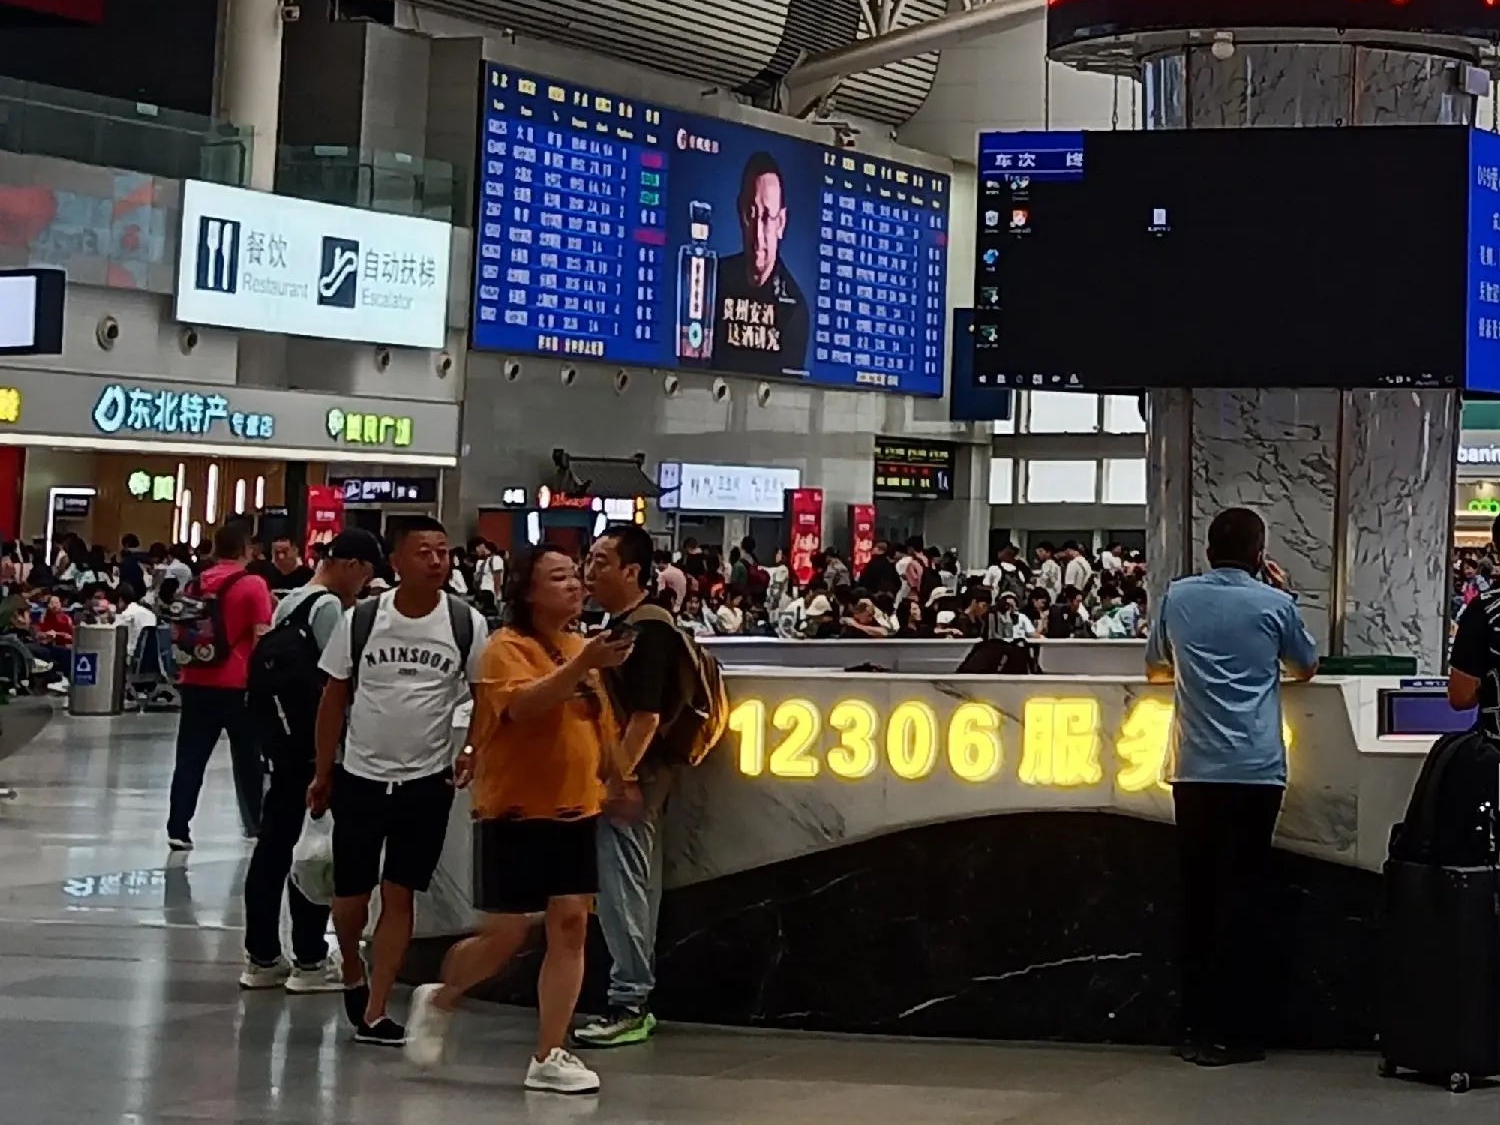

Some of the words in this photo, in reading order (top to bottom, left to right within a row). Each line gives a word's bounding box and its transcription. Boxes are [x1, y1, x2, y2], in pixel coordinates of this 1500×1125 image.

[246, 231, 287, 269] 餐饮
[363, 248, 436, 288] 自动扶梯
[242, 273, 308, 300] Restaurant
[361, 288, 413, 310] Escalator
[128, 388, 228, 432] 东北特产
